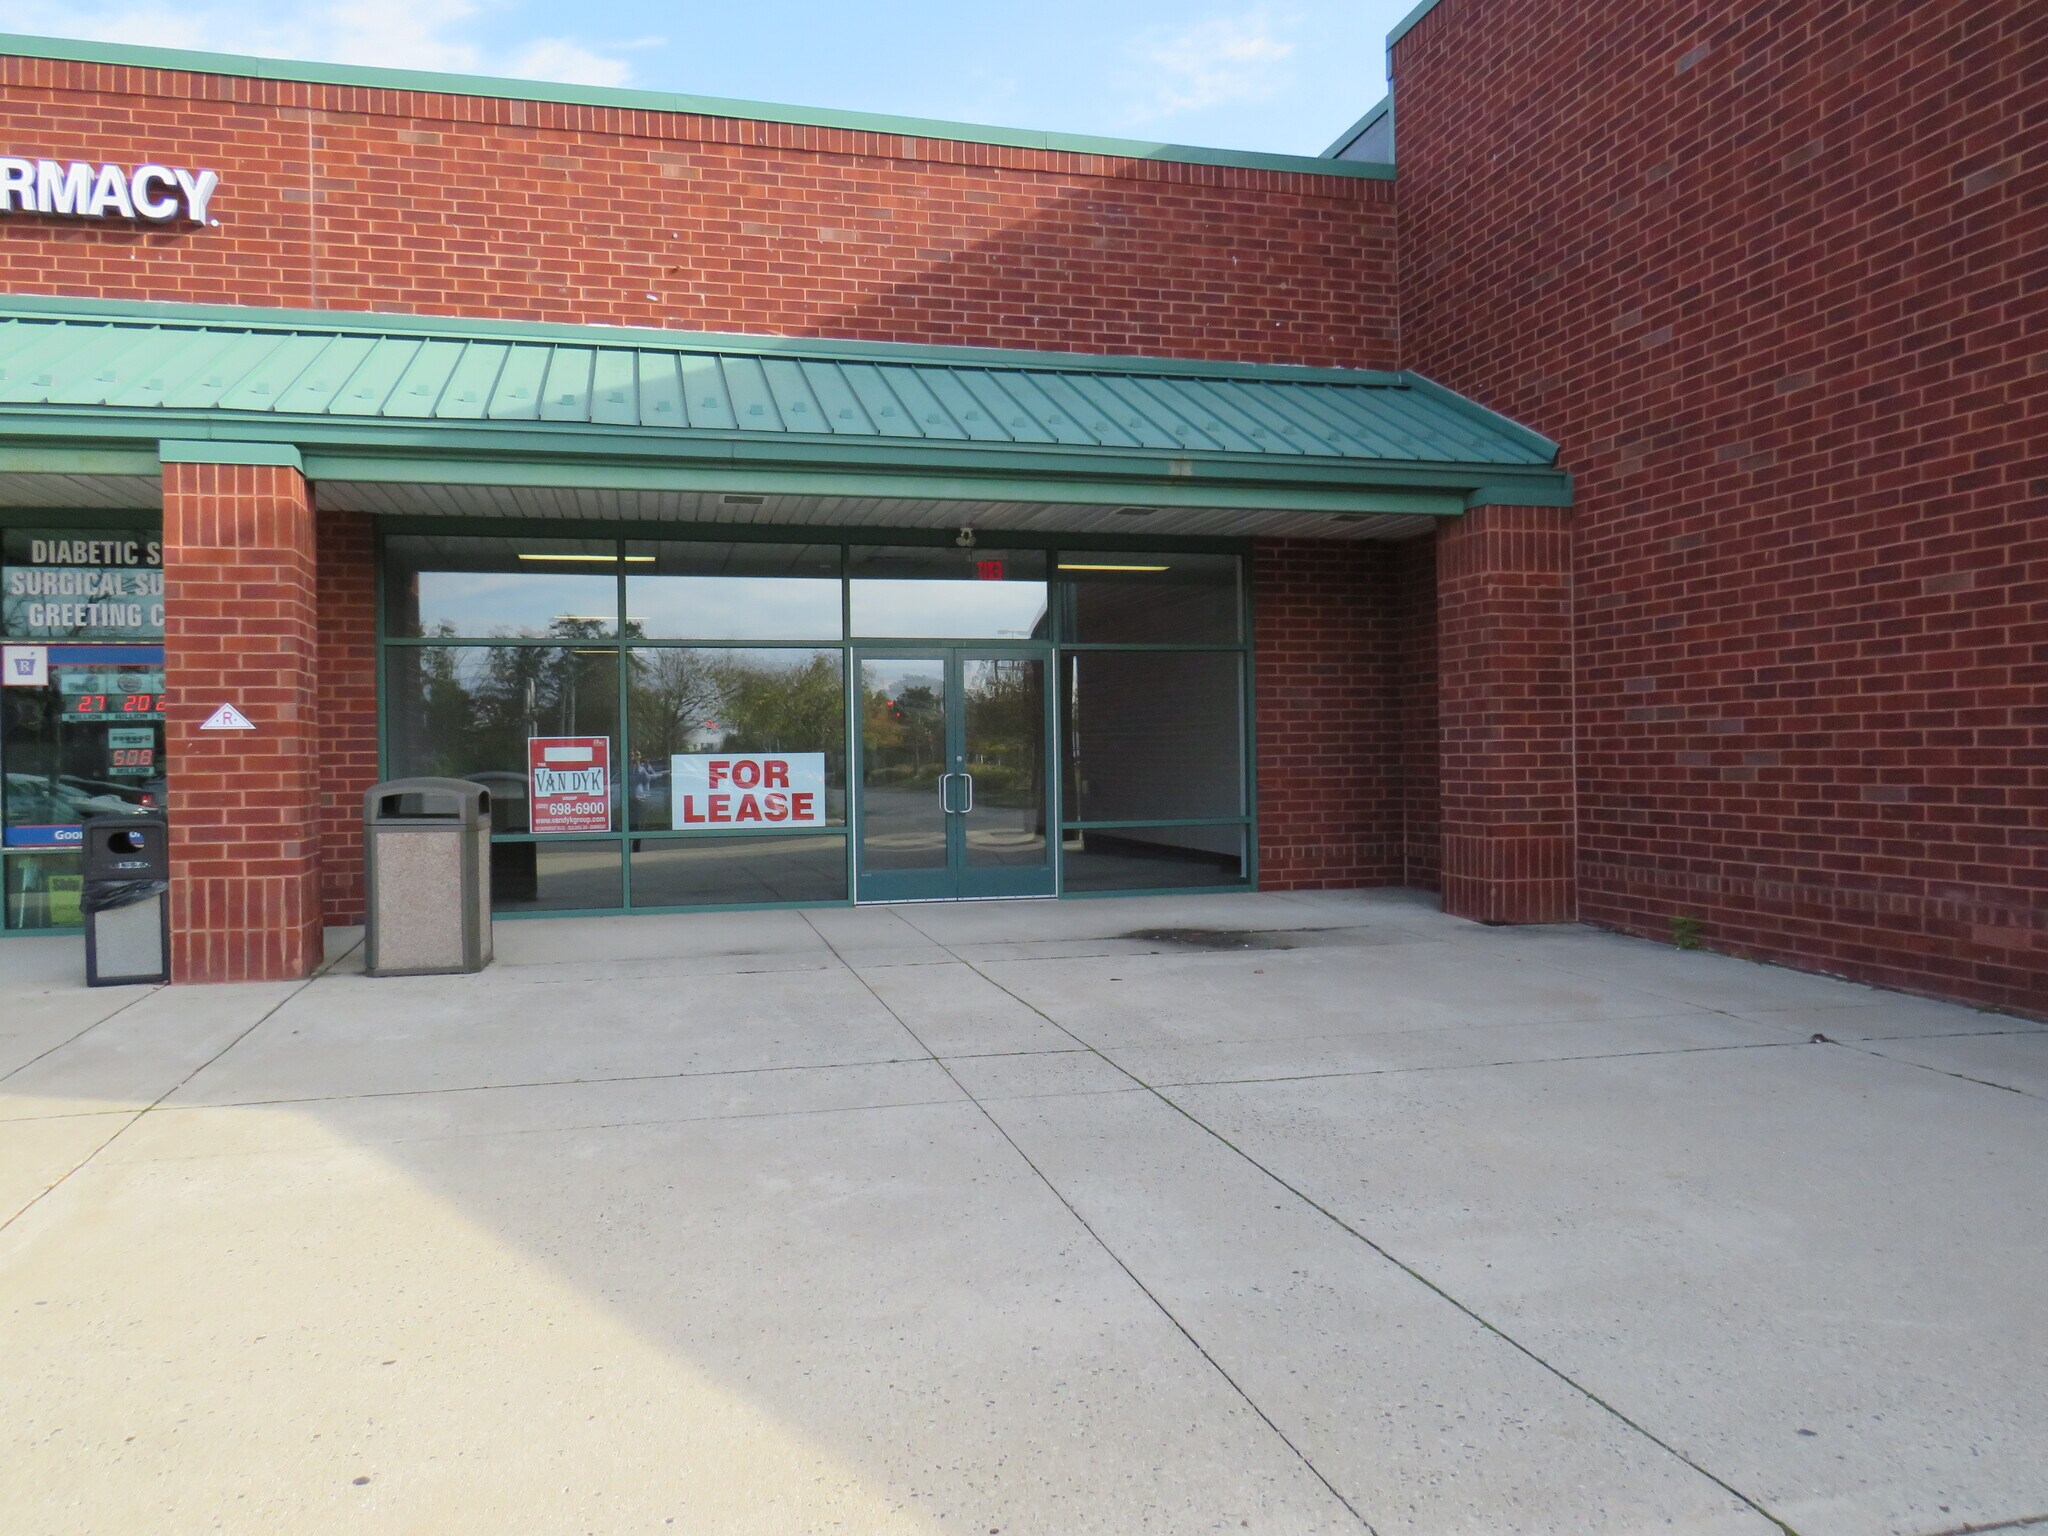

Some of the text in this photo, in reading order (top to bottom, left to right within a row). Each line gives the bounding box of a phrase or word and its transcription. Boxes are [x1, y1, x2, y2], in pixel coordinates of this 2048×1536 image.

[31, 540, 138, 564] DIABETIC
[11, 572, 128, 596] SURGICAL
[29, 603, 142, 627] GREETING
[78, 695, 107, 713] 27
[223, 711, 233, 725] R
[536, 768, 602, 792] VAN DYK
[708, 759, 790, 789] FOR
[549, 802, 605, 815] 698-6900
[683, 792, 815, 823] LEASE
